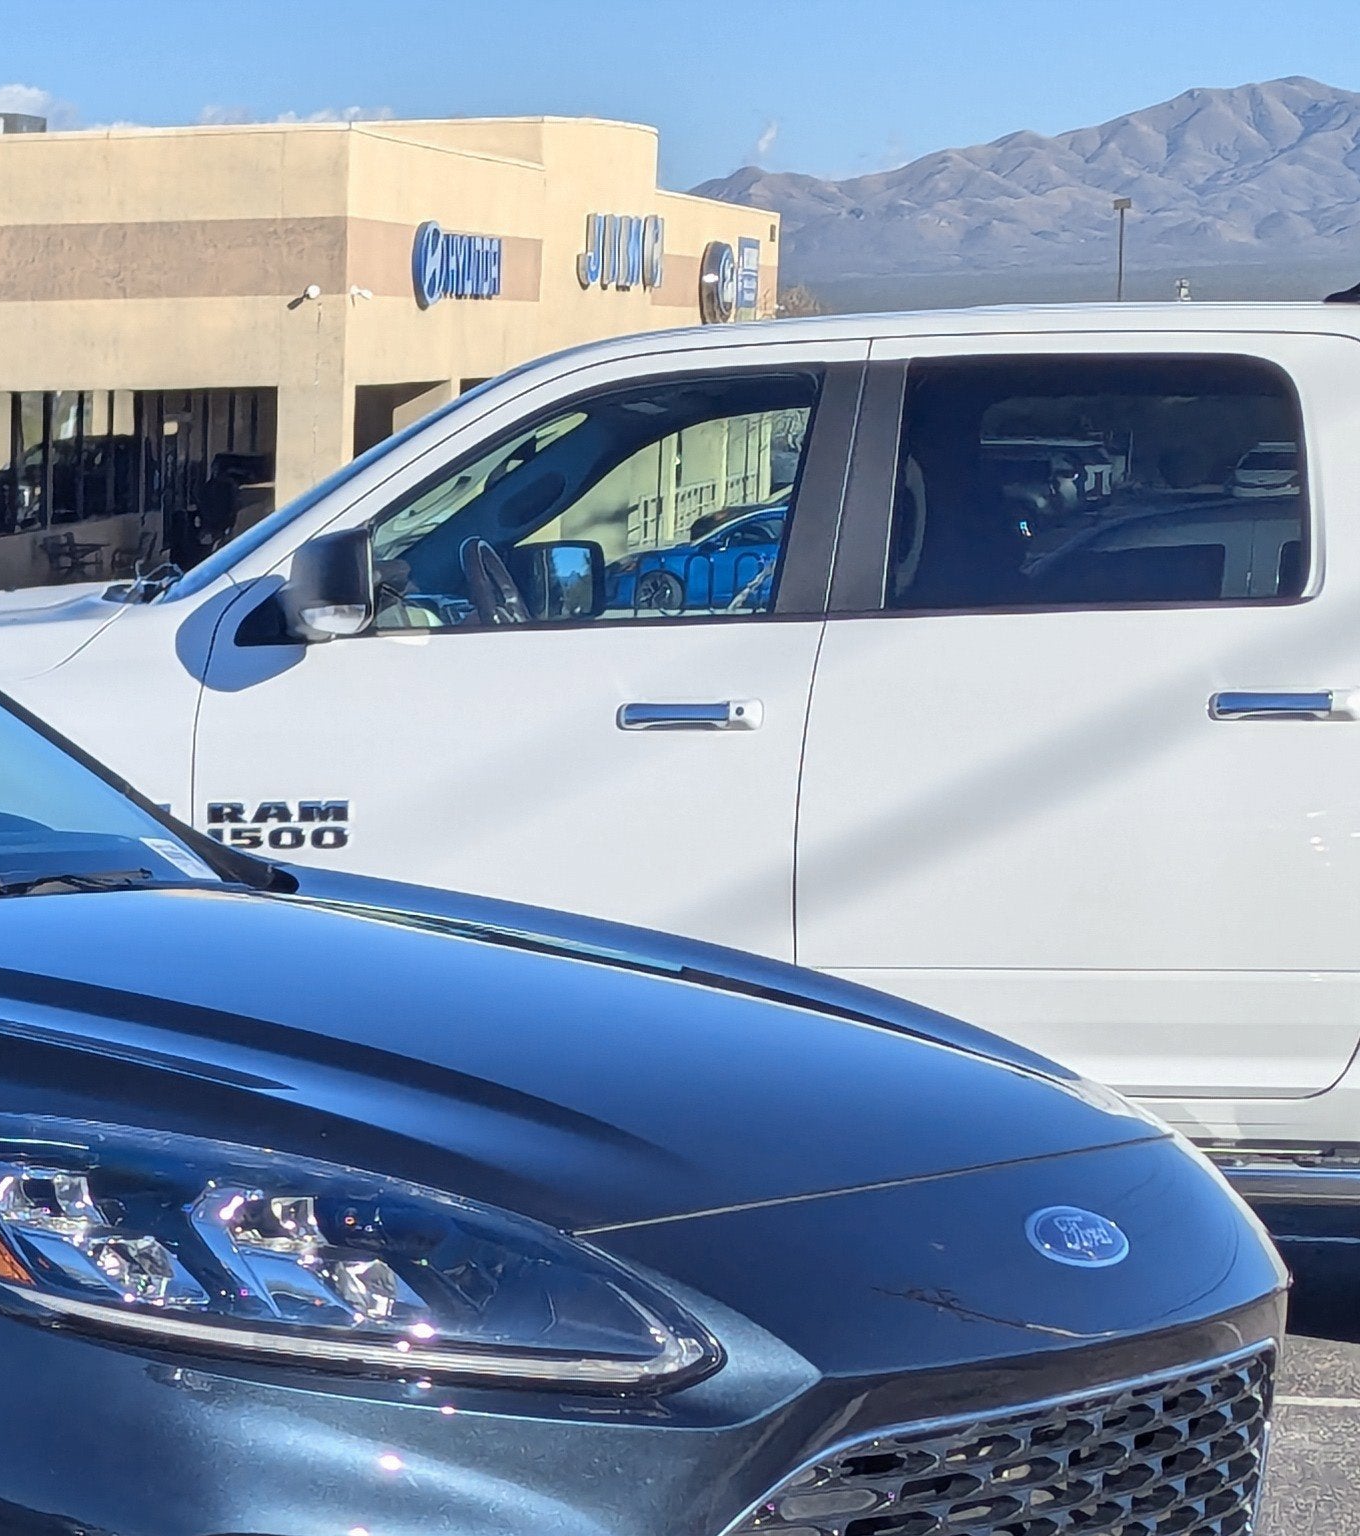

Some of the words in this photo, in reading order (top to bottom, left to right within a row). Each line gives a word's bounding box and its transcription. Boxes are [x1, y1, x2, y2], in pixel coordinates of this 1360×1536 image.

[207, 800, 348, 824] RAM
[207, 826, 348, 849] 1500
[1053, 1216, 1113, 1252] Ford
